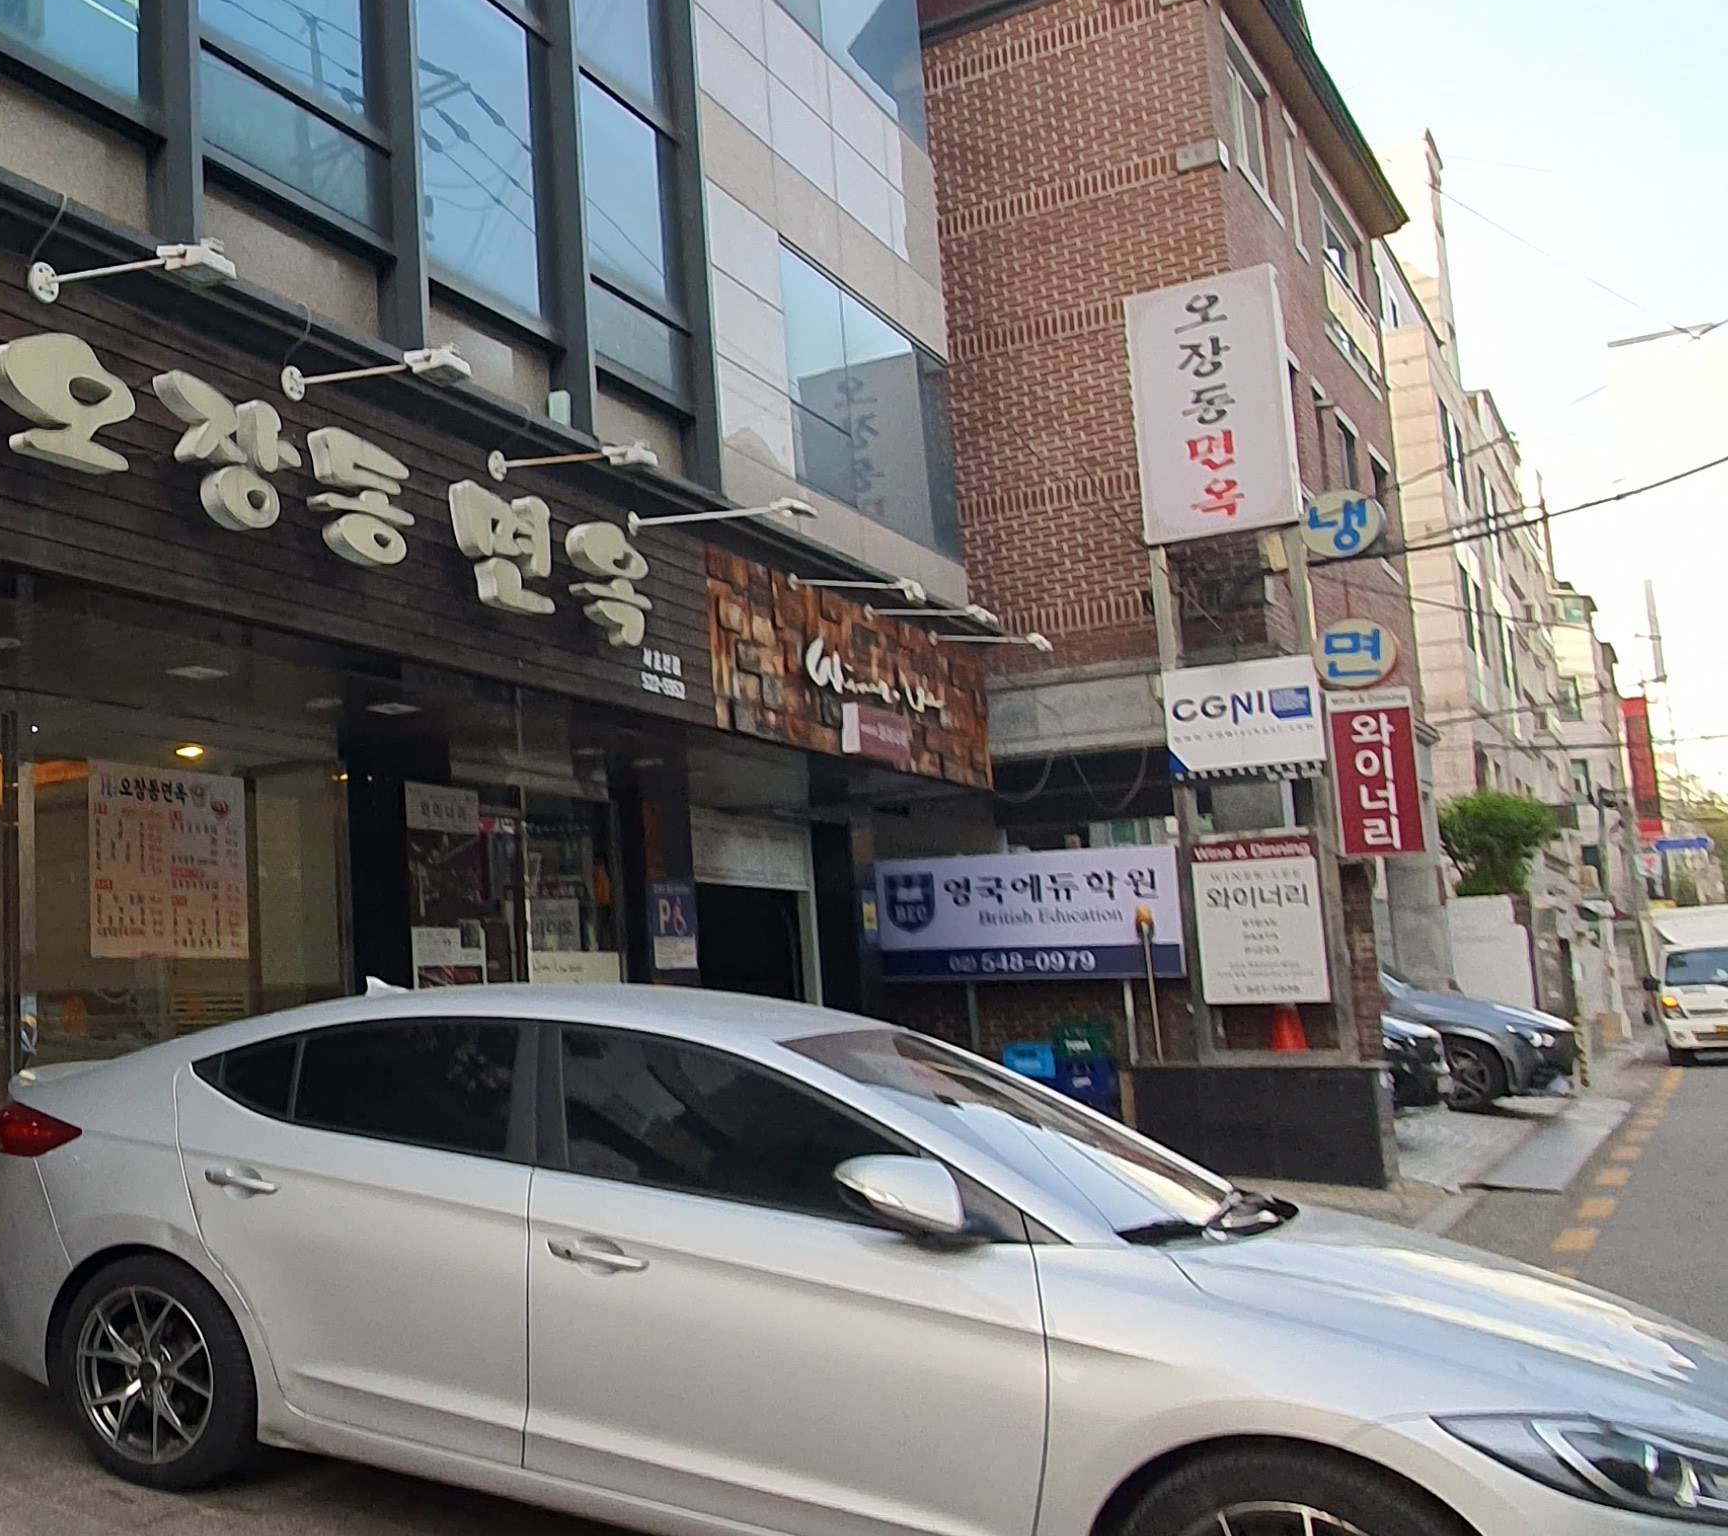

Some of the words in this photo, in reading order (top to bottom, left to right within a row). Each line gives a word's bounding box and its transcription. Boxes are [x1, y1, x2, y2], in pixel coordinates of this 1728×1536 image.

[1350, 710, 1402, 852] 와이너리
[943, 866, 1159, 906] 영국에듀학원
[1207, 883, 1311, 911] 와이너리
